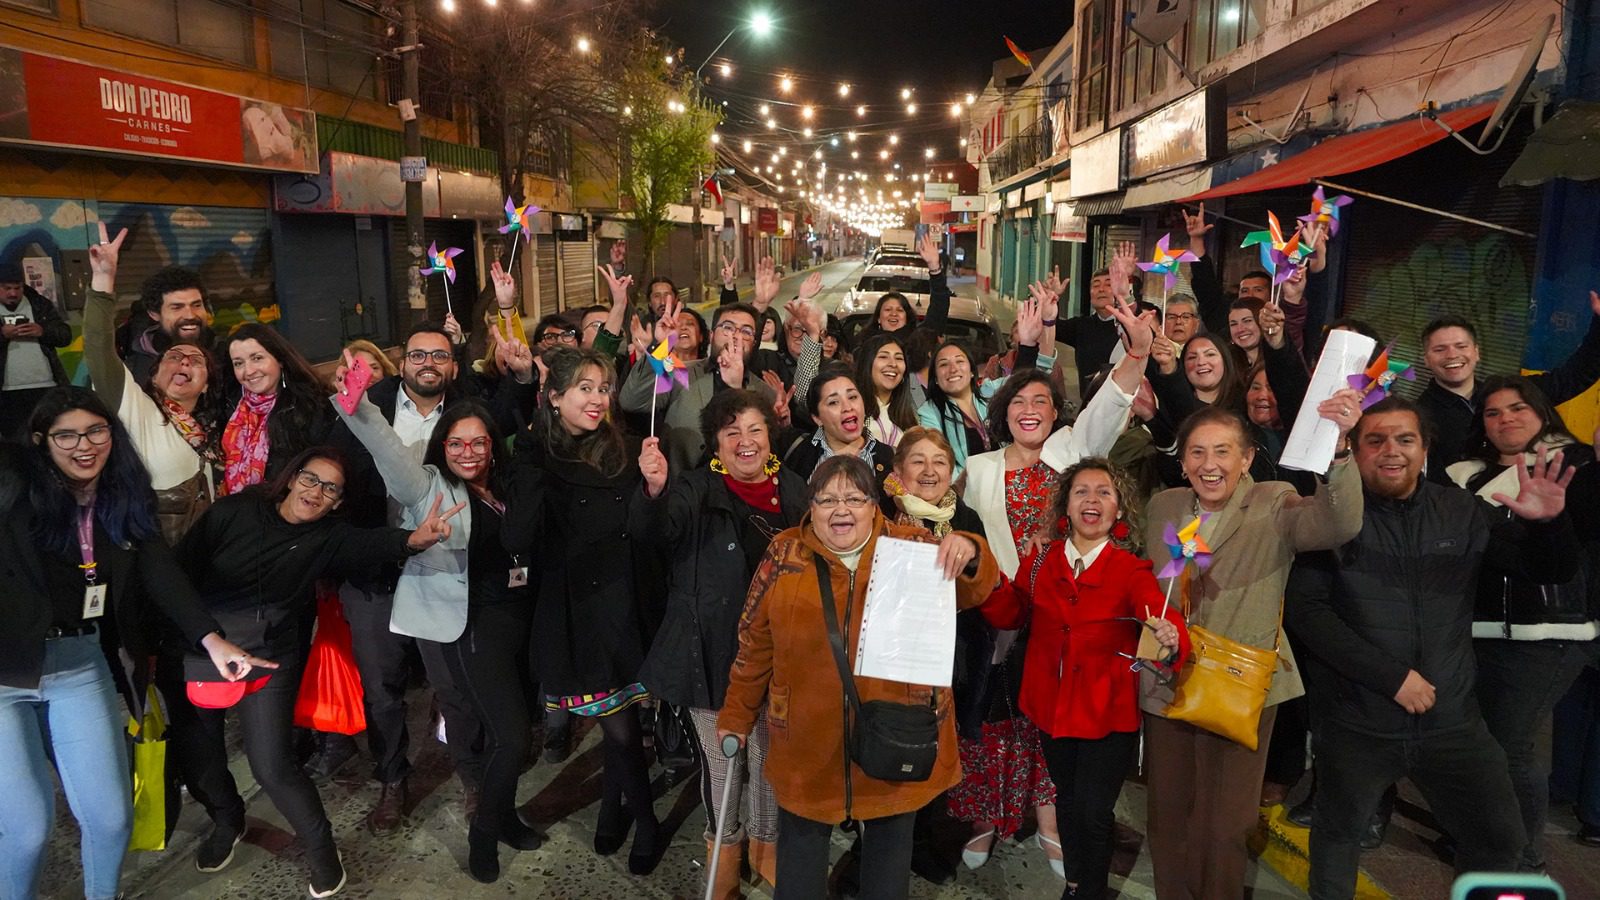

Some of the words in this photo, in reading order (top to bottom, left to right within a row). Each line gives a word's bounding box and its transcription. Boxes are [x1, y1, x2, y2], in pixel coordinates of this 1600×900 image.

[99, 77, 137, 114] DON
[139, 86, 192, 124] PEDRO
[128, 118, 171, 133] CARNES
